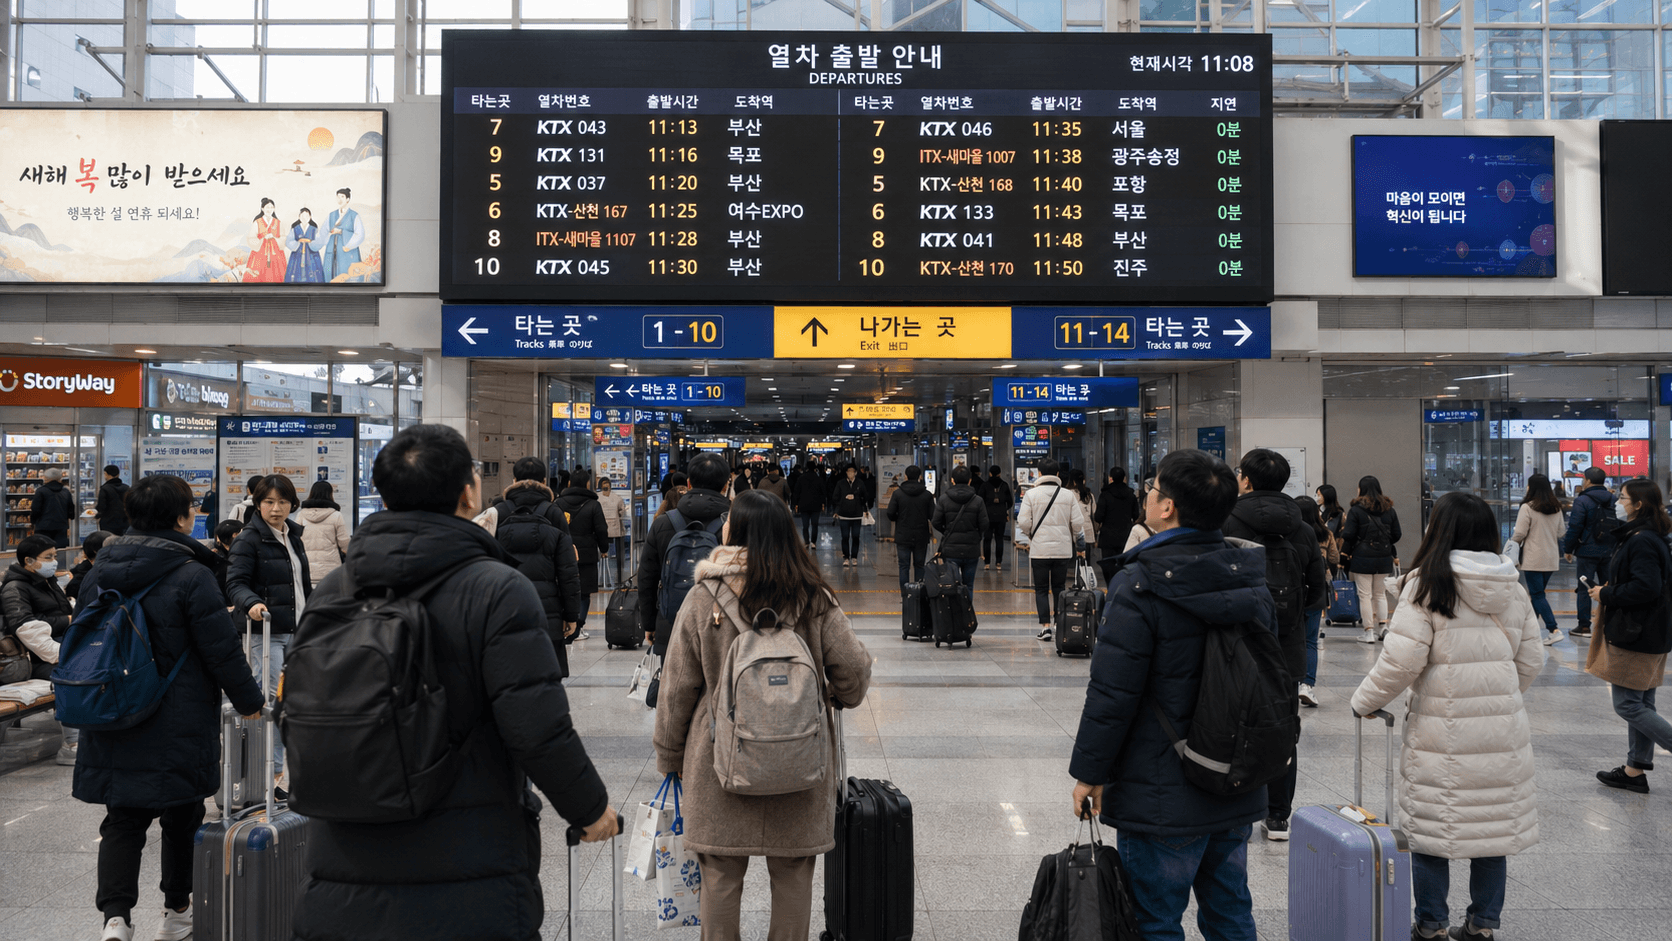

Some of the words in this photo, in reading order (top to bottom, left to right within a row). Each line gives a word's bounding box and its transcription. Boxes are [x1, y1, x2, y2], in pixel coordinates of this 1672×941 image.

[769, 44, 819, 68] 열차
[830, 44, 881, 68] 출발
[893, 45, 941, 69] 안내
[1130, 55, 1193, 71] 현재시각
[1202, 55, 1253, 72] 11:08
[810, 72, 903, 85] DEPARTURES
[472, 94, 511, 108] 타는곳
[539, 93, 591, 108] 열차번호
[647, 94, 699, 108] 출발시간
[735, 94, 773, 109] 도착역
[855, 95, 894, 109] 타는곳
[921, 95, 974, 110] 열차번호
[1031, 95, 1083, 110] 출발시간
[1118, 96, 1157, 110] 도착역
[1211, 96, 1237, 111] 지연
[490, 119, 502, 135] 7
[537, 119, 574, 134] KTX
[578, 120, 607, 134] 043
[649, 119, 698, 134] 11:13
[728, 119, 762, 136] 부산
[872, 120, 885, 136] 7
[920, 121, 957, 136] KTX
[962, 121, 993, 136] 046
[1033, 121, 1082, 136] 11:35
[1112, 121, 1145, 138] 서울
[1217, 121, 1242, 137] 0분
[489, 146, 501, 162] 9
[537, 147, 573, 162] KTX
[579, 148, 604, 162] 131
[649, 147, 698, 162] 11:16
[728, 147, 761, 164] 목포
[872, 148, 884, 164] 9
[986, 150, 1016, 164] 1007
[1033, 148, 1082, 163] 11:38
[1112, 148, 1179, 165] 광주송정
[1218, 149, 1242, 165] 0분
[20, 165, 66, 185] 새해
[76, 158, 99, 193] 복
[108, 163, 150, 189] 많이
[166, 163, 250, 188] 받으세요
[489, 174, 501, 190] 5
[537, 175, 573, 190] KTX
[578, 175, 606, 190] 037
[649, 174, 698, 190] 11:20
[728, 174, 762, 192] 부산
[1033, 176, 1083, 191] 11:40
[872, 176, 884, 192] 5
[921, 176, 983, 192] KTX-산천
[990, 178, 1013, 192] 168
[1113, 176, 1146, 193] 포항
[1218, 176, 1243, 192] 0분
[1387, 191, 1424, 205] 마음이
[1428, 191, 1466, 205] 모이면
[68, 206, 106, 220] 행복한
[110, 206, 122, 220] 설
[128, 206, 153, 220] 연휴
[158, 206, 200, 220] 되세요!
[488, 202, 501, 218] 6
[537, 203, 599, 219] KTX-산천
[604, 205, 628, 218] 167
[649, 203, 698, 218] 11:25
[729, 202, 803, 220] 여수EXPO
[872, 203, 884, 220] 6
[920, 204, 958, 219] KTX
[964, 204, 994, 219] 133
[1034, 204, 1082, 219] 11:43
[1113, 204, 1146, 221] 목포
[1218, 204, 1243, 220] 0분
[1387, 208, 1424, 223] 혁신이
[1428, 209, 1467, 223] 됩니다
[487, 230, 500, 246] 8
[537, 231, 601, 247] ITX-새마을
[606, 232, 637, 246] 1107
[649, 230, 698, 246] 11:28
[728, 230, 762, 248] 부산
[872, 231, 884, 248] 8
[920, 232, 958, 247] KTX
[963, 232, 993, 247] 041
[1034, 232, 1083, 247] 11:48
[1113, 231, 1147, 249] 부산
[1219, 232, 1243, 248] 0분
[475, 258, 499, 275] 10
[536, 259, 573, 274] KTX
[578, 259, 610, 274] 045
[649, 259, 698, 274] 11:30
[728, 259, 762, 276] 부산
[860, 259, 884, 276] 10
[921, 260, 984, 276] KTX-산천
[990, 261, 1014, 275] 170
[1034, 260, 1083, 275] 11:50
[1114, 259, 1147, 277] 진주
[1219, 260, 1244, 276] 0분
[516, 315, 554, 335] 타는
[563, 316, 581, 335] 곳
[861, 317, 921, 337] 나가는
[937, 317, 955, 337] 곳
[1147, 317, 1184, 337] 타는
[1192, 318, 1209, 337] 곳
[515, 338, 545, 349] Tracks
[861, 340, 880, 351] Exit
[1147, 340, 1172, 350] Tracks
[24, 373, 114, 394] StoryWay
[1604, 455, 1636, 466] SALE
